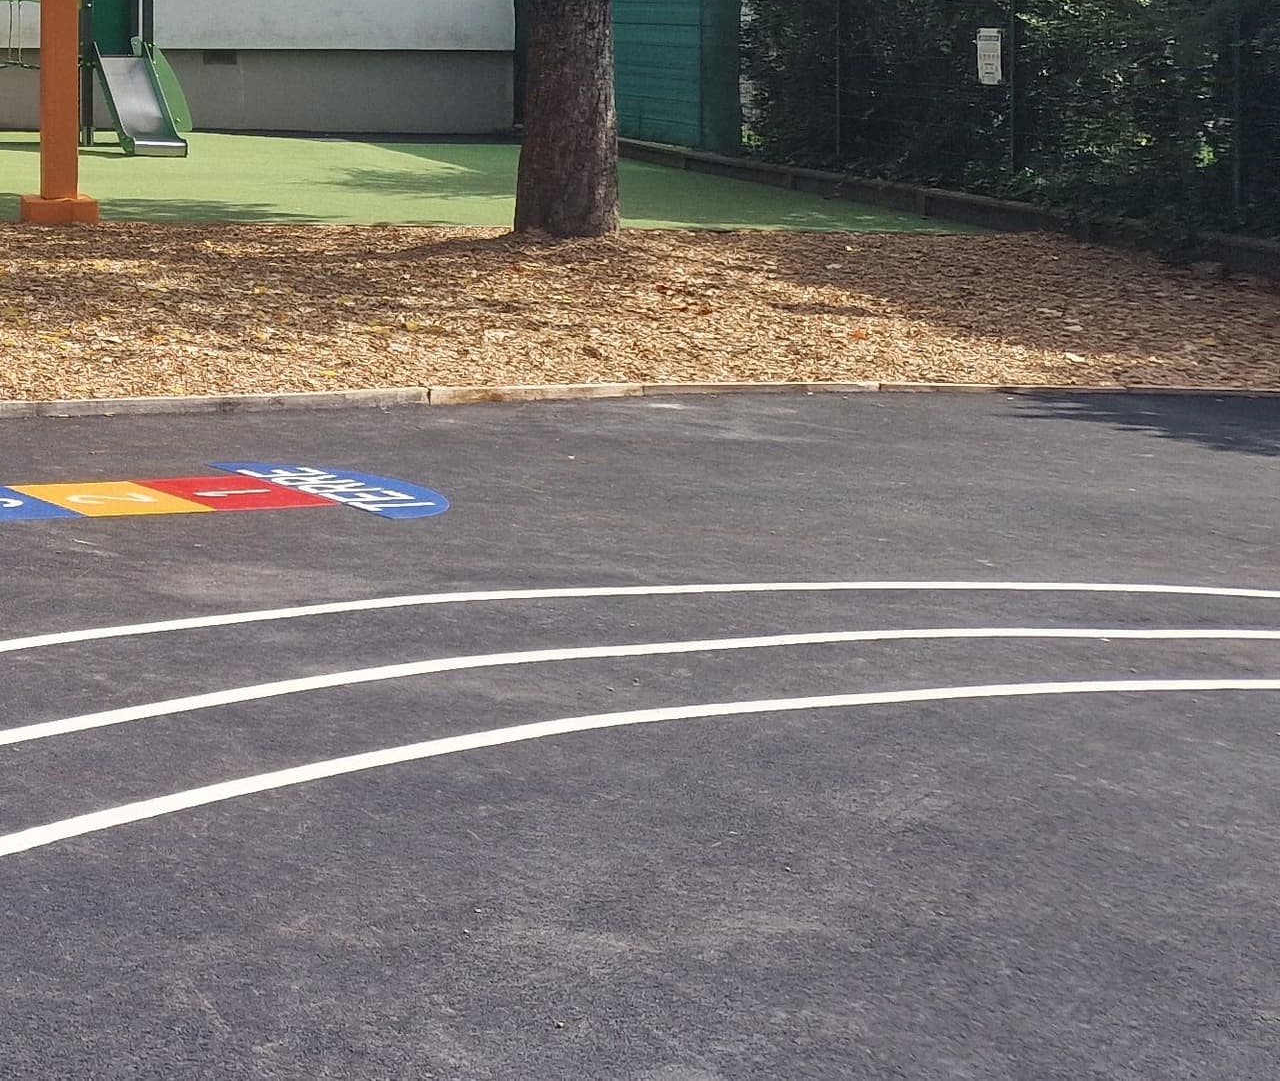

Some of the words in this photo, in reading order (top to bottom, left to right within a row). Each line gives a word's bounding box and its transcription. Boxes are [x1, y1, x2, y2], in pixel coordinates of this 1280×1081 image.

[192, 489, 272, 498] 1
[236, 467, 436, 511] TERRE
[66, 493, 158, 506] 2
